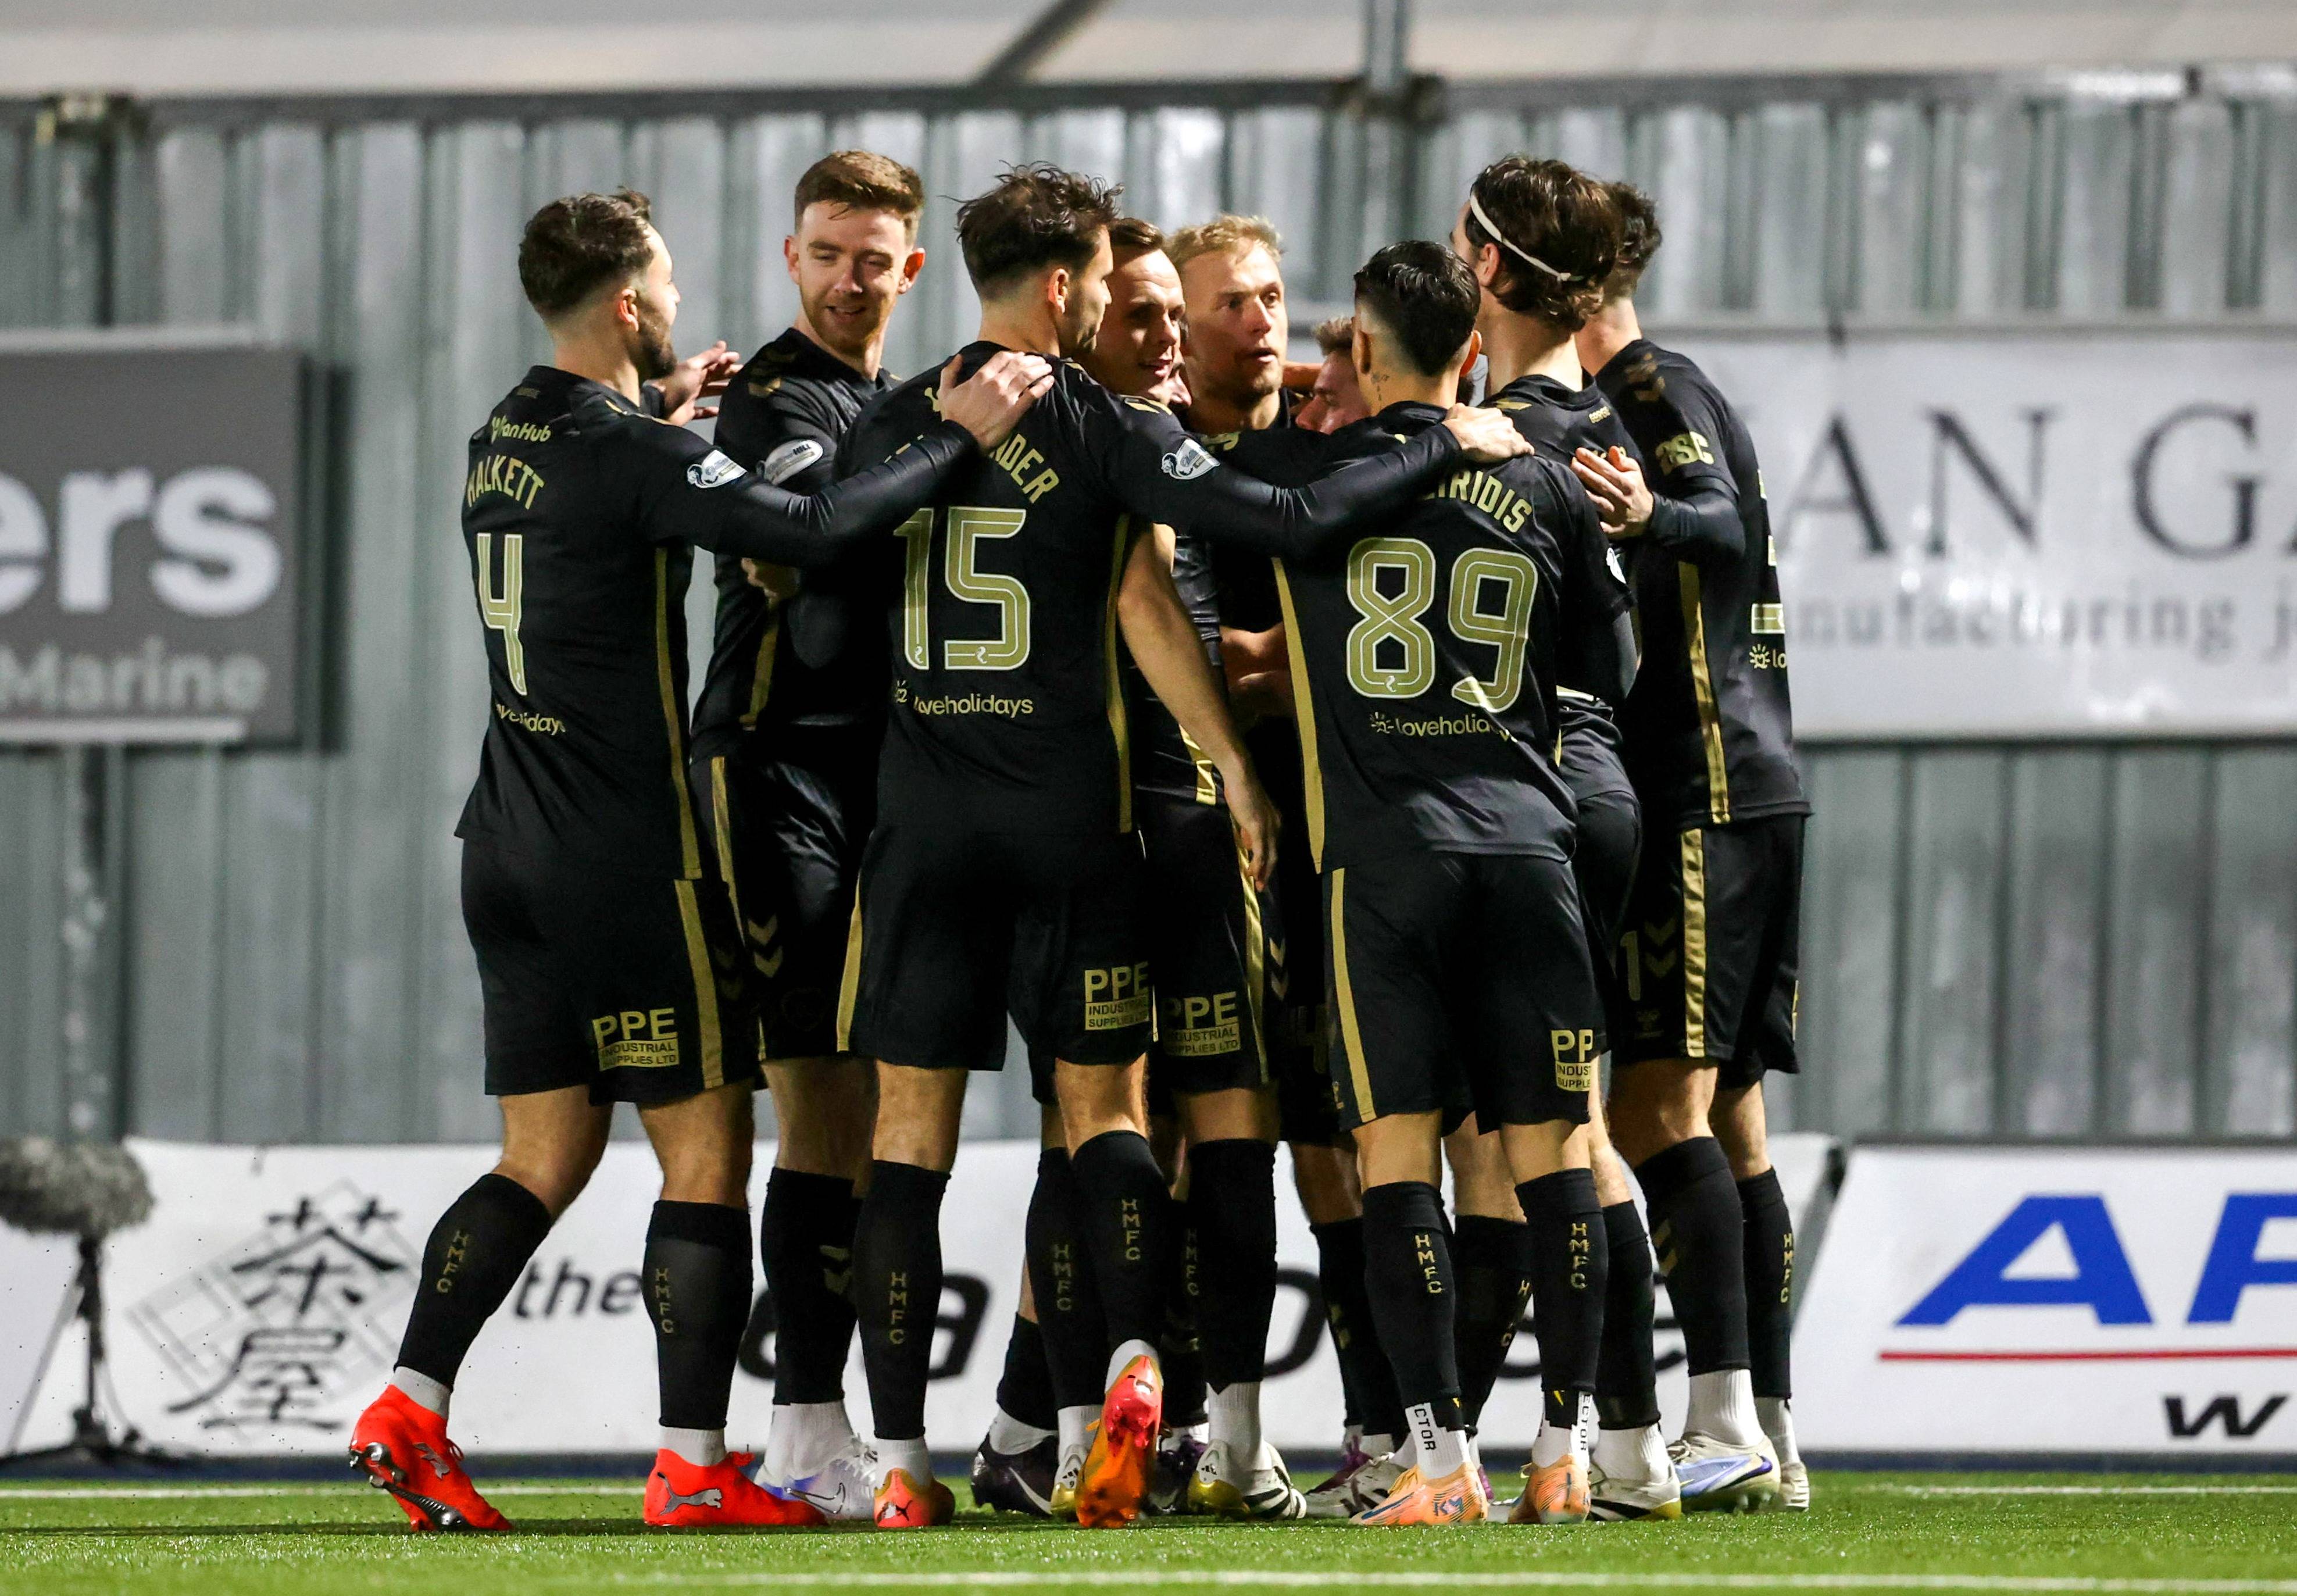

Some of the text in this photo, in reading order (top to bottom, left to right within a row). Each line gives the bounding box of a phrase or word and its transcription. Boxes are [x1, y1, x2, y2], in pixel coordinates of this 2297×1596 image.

[2131, 400, 2297, 563] G
[477, 532, 527, 695] 4
[894, 508, 1031, 670] 15
[1347, 537, 1538, 713] 89
[1084, 961, 1149, 1002] PPE
[592, 1008, 678, 1049] PPE
[656, 1055, 676, 1064] LTD
[1219, 1040, 1238, 1052] LTD
[436, 1230, 470, 1294] HMFC
[1121, 1198, 1141, 1261] HMFC
[1569, 1222, 1590, 1289] HMFC
[515, 1257, 642, 1316] the
[1053, 1244, 1072, 1311] HMFC
[1414, 1234, 1444, 1294] HMFC
[1780, 1233, 1794, 1303] HMFC
[655, 1267, 674, 1334] HMFC
[889, 1271, 907, 1345] HMFC
